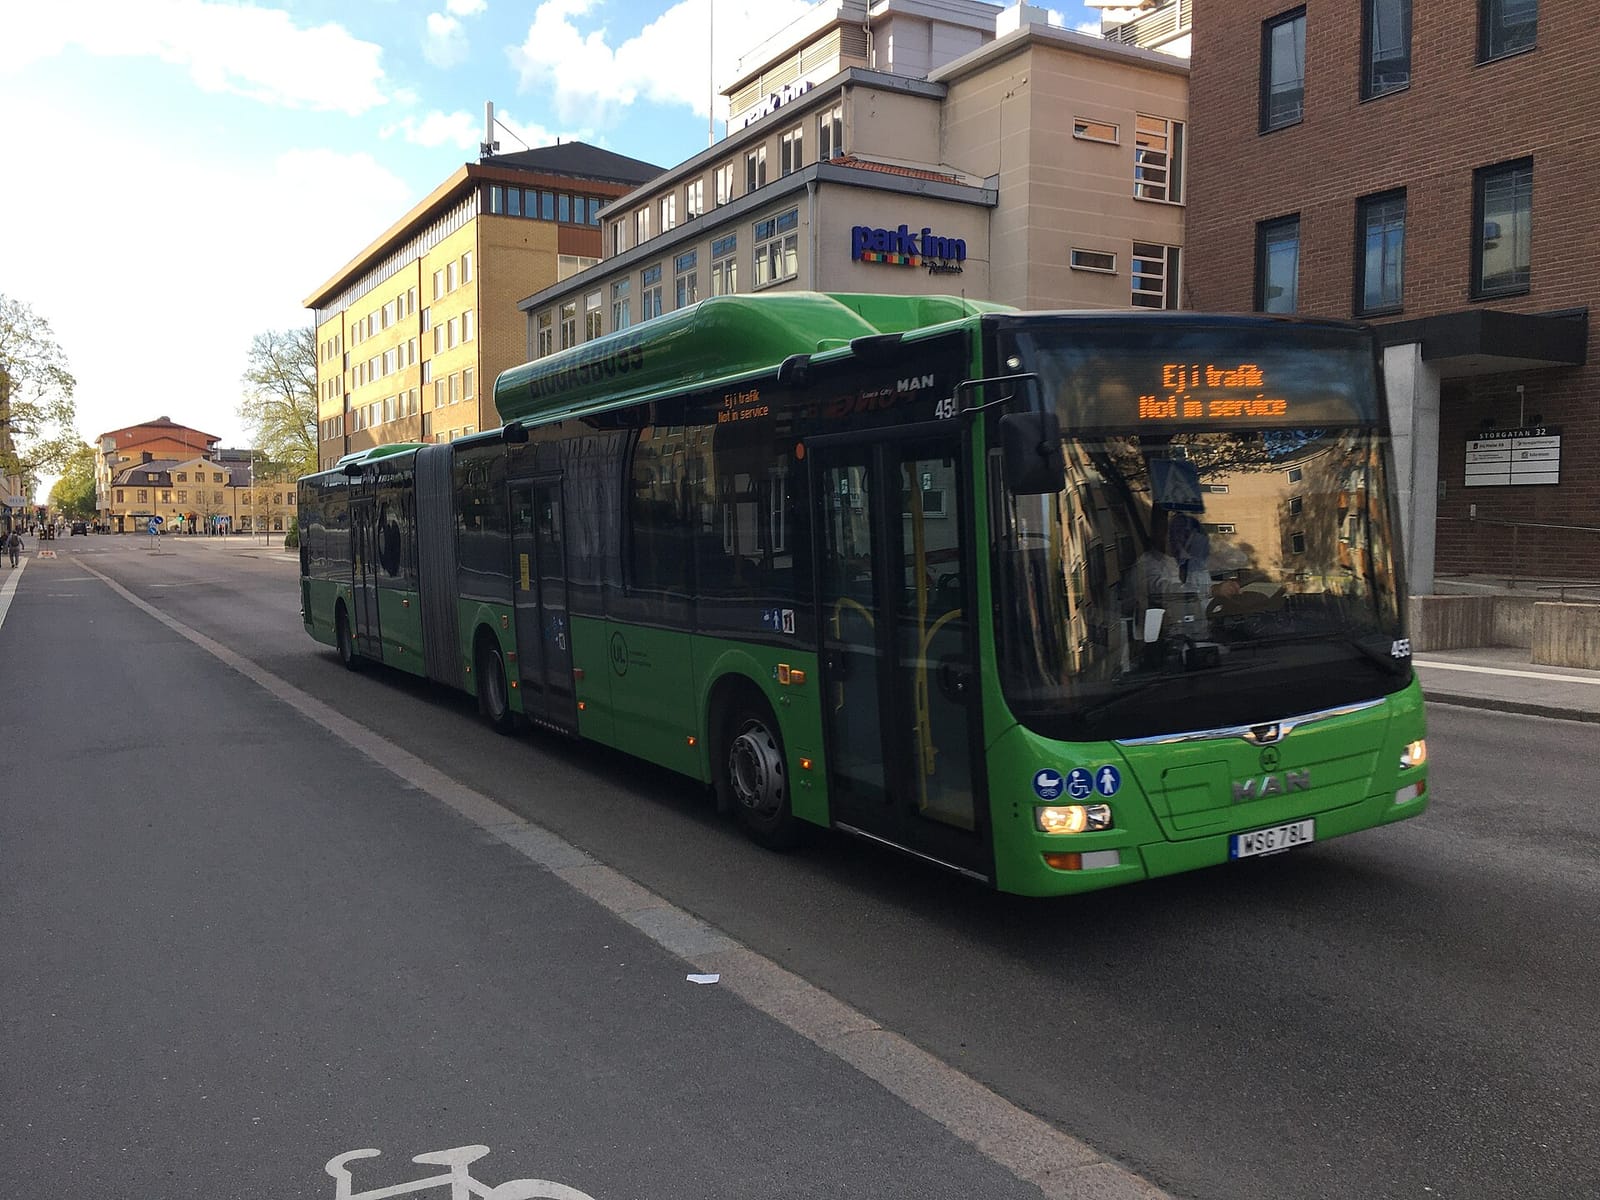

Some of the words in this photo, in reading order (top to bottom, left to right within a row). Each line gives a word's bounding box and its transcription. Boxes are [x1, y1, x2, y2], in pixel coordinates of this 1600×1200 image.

[852, 224, 920, 261] park
[921, 227, 967, 261] inn
[897, 374, 934, 393] MAN
[1163, 364, 1186, 393] Ej
[1191, 364, 1200, 387] i
[1205, 364, 1264, 387] trafik
[724, 394, 733, 409] Ej
[738, 389, 760, 404] trafik
[1139, 395, 1177, 418] Not
[1183, 395, 1203, 416] in
[1208, 394, 1288, 416] service
[718, 409, 730, 423] Not
[731, 409, 739, 421] in
[740, 405, 769, 420] service
[1479, 430, 1530, 439] STORGATAN
[1535, 428, 1546, 436] 32
[1232, 767, 1310, 803] MAN
[1243, 830, 1276, 853] WSG
